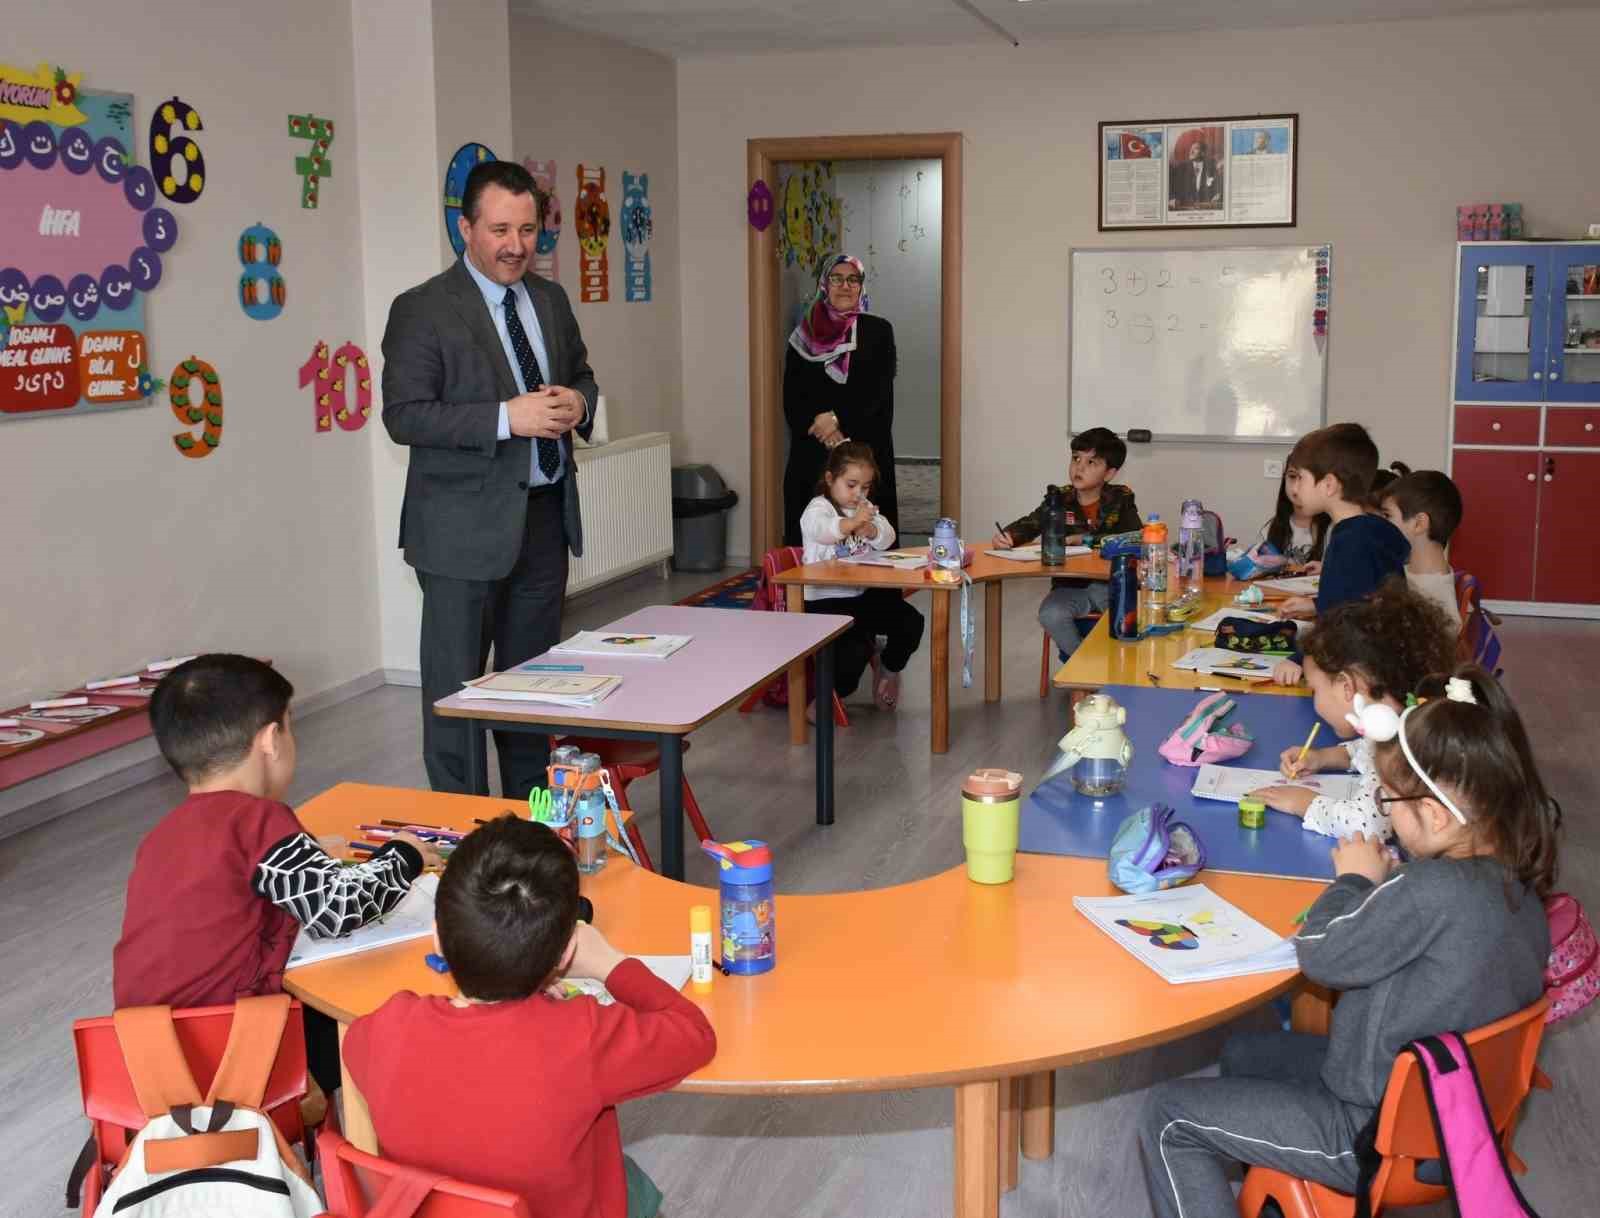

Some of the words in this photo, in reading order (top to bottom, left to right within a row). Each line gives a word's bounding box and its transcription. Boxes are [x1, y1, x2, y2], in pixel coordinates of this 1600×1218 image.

[150, 97, 206, 204] 6
[287, 114, 335, 209] 7
[238, 222, 287, 321] 8
[170, 355, 224, 459] 9
[298, 341, 372, 432] 10
